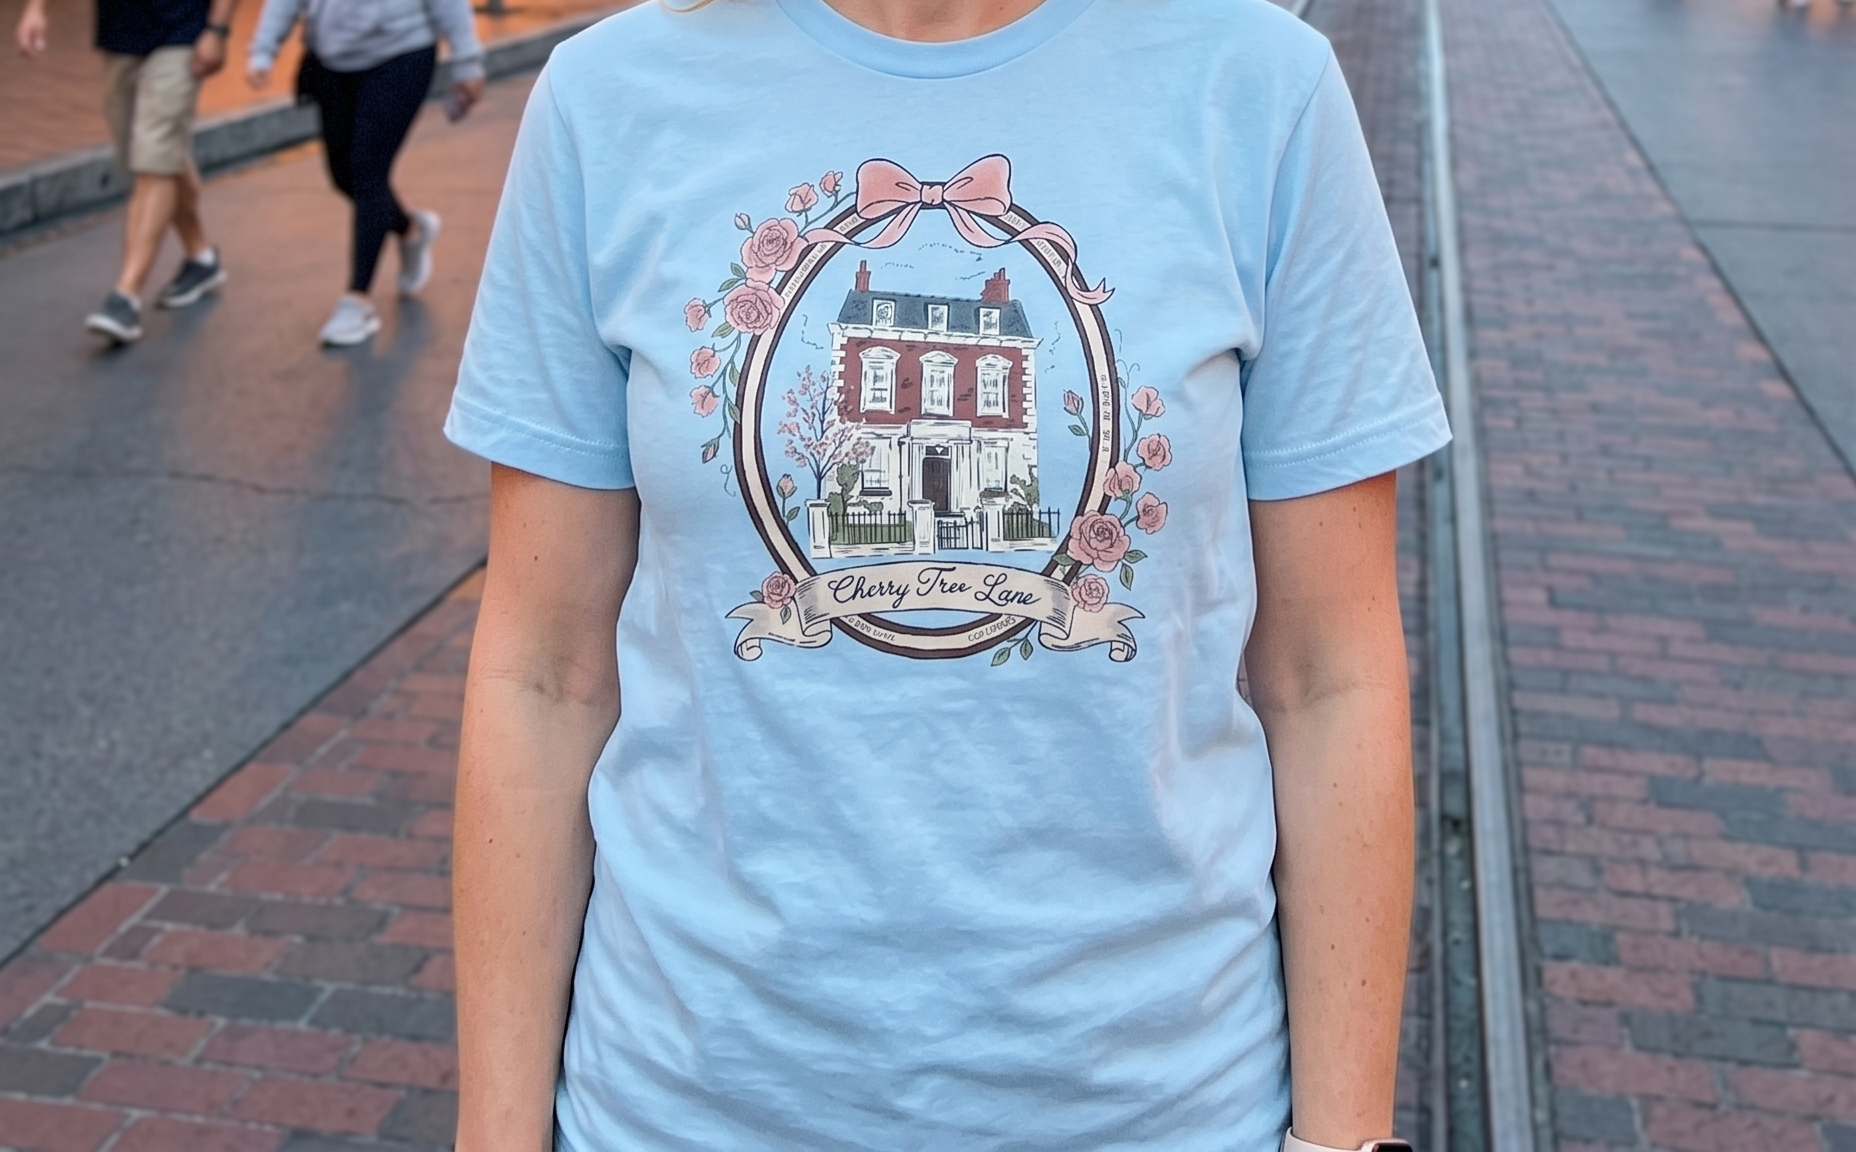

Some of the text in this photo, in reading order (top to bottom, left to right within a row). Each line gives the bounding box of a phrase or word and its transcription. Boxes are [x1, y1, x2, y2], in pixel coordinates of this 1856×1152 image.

[827, 566, 1042, 609] Cherry Tree Lane
